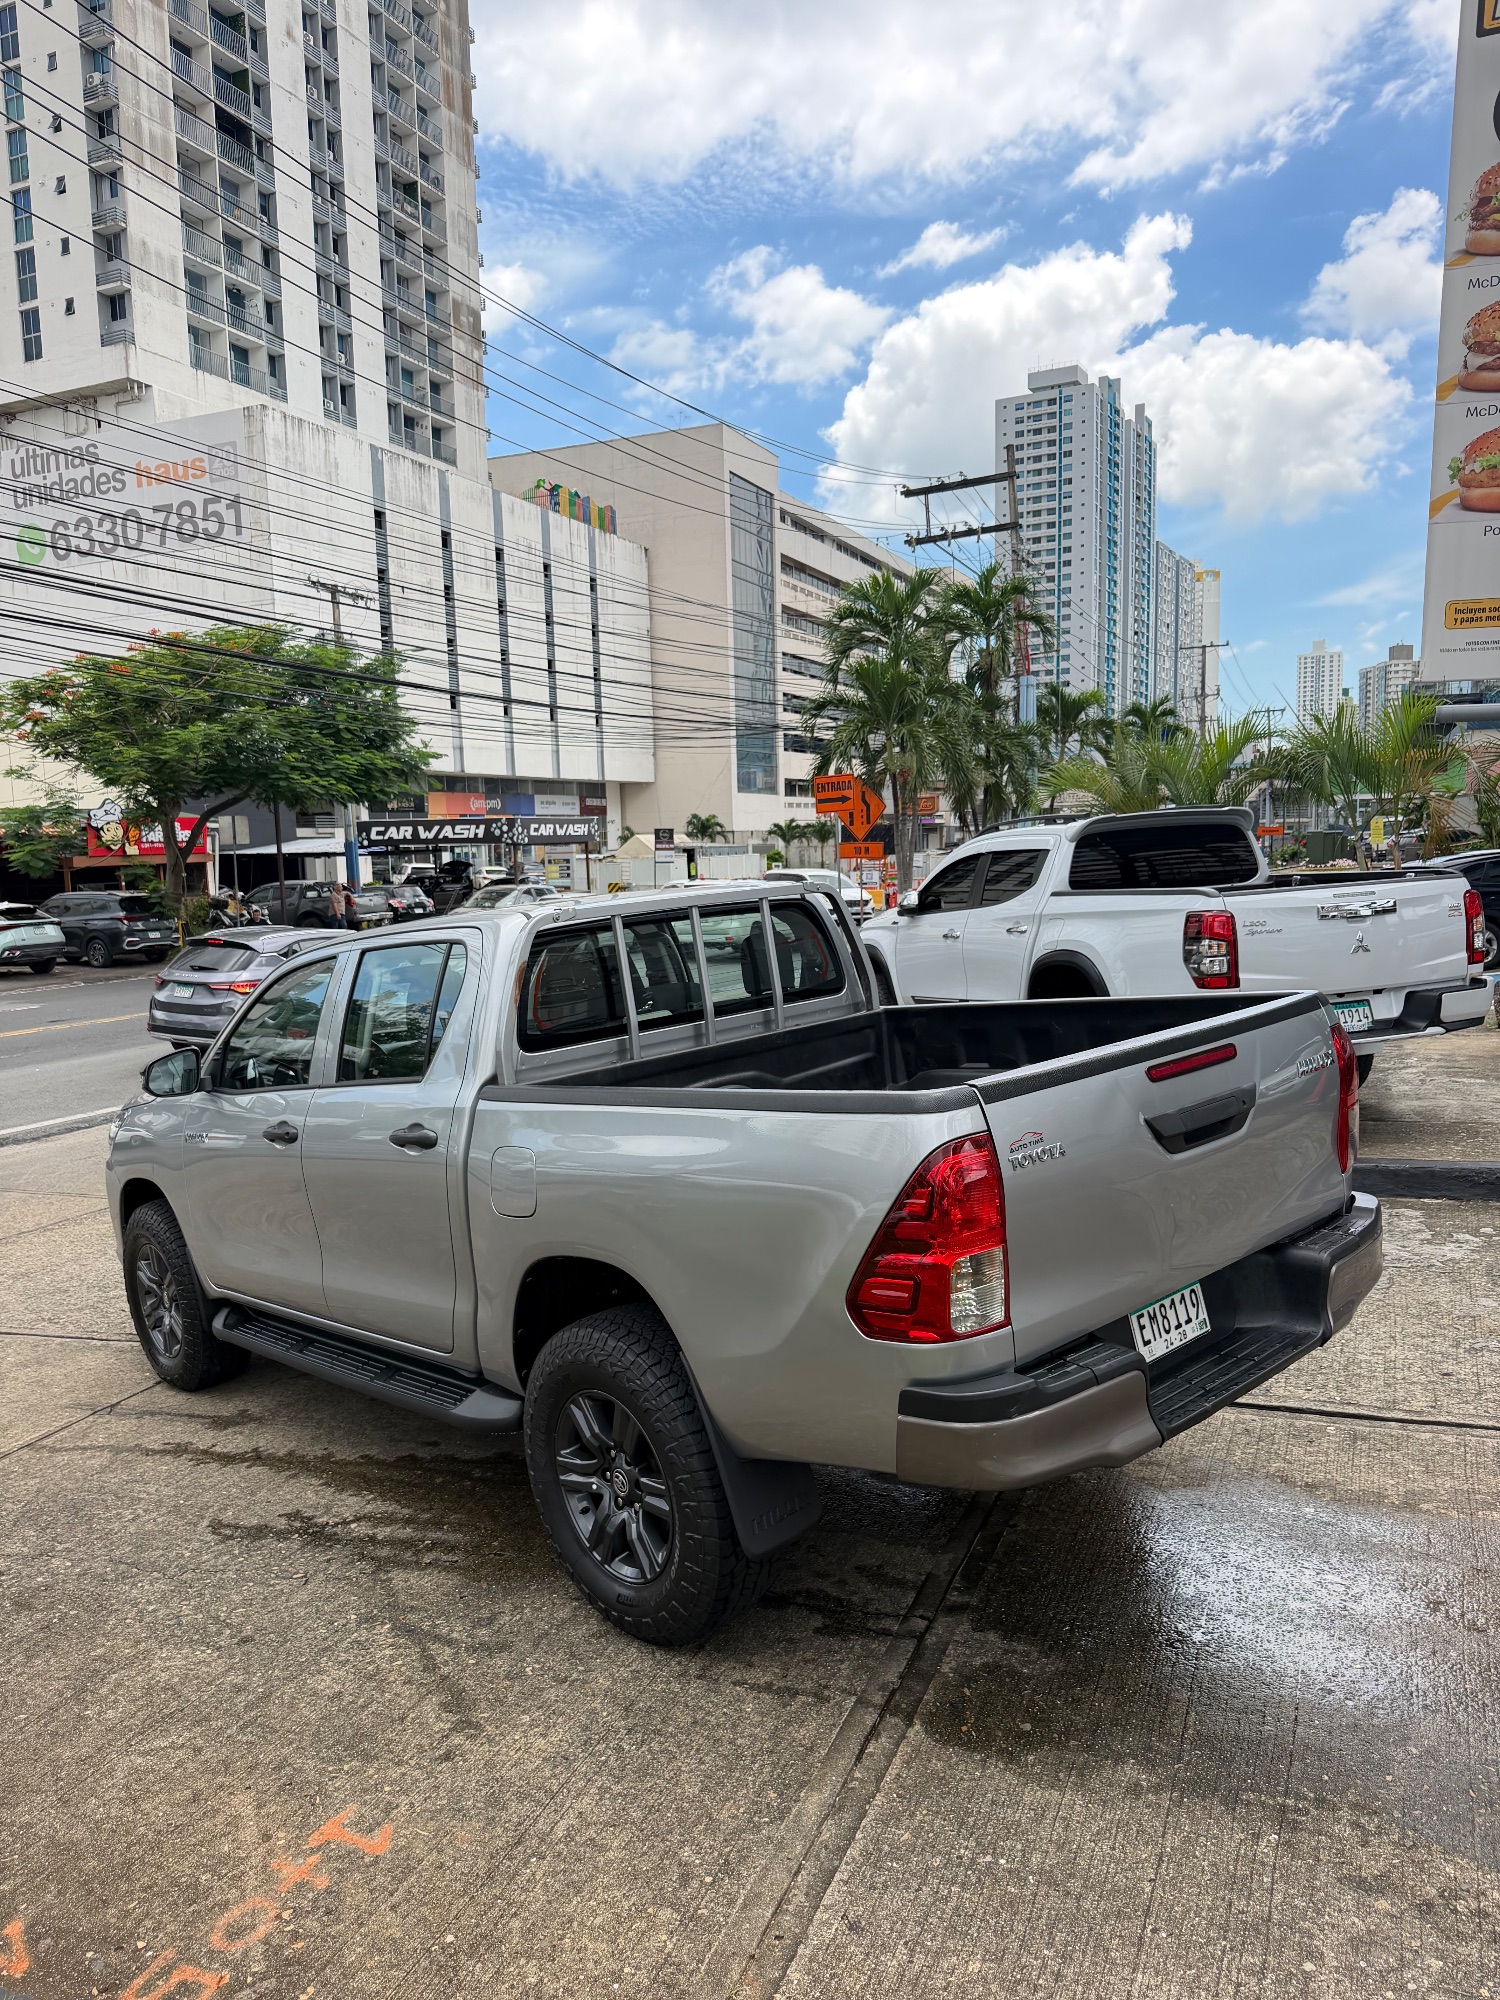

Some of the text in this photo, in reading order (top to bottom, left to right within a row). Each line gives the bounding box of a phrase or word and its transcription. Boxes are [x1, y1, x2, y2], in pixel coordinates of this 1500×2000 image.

[1466, 404, 1500, 418] McD
[10, 442, 100, 479] últimas
[135, 457, 207, 489] haus
[13, 465, 127, 509] unidades
[50, 493, 243, 562] 6330-7851
[1454, 606, 1487, 616] Incluyen
[1460, 615, 1484, 626] papas
[816, 780, 853, 794] ENTRADA
[370, 824, 486, 841] CAR WASH
[529, 823, 589, 836] CAR WASH
[1336, 1007, 1370, 1025] 1914
[1009, 1136, 1045, 1153] AUTO TIME
[1008, 1142, 1067, 1171] TOYOTA
[1136, 1287, 1201, 1348] EM8119
